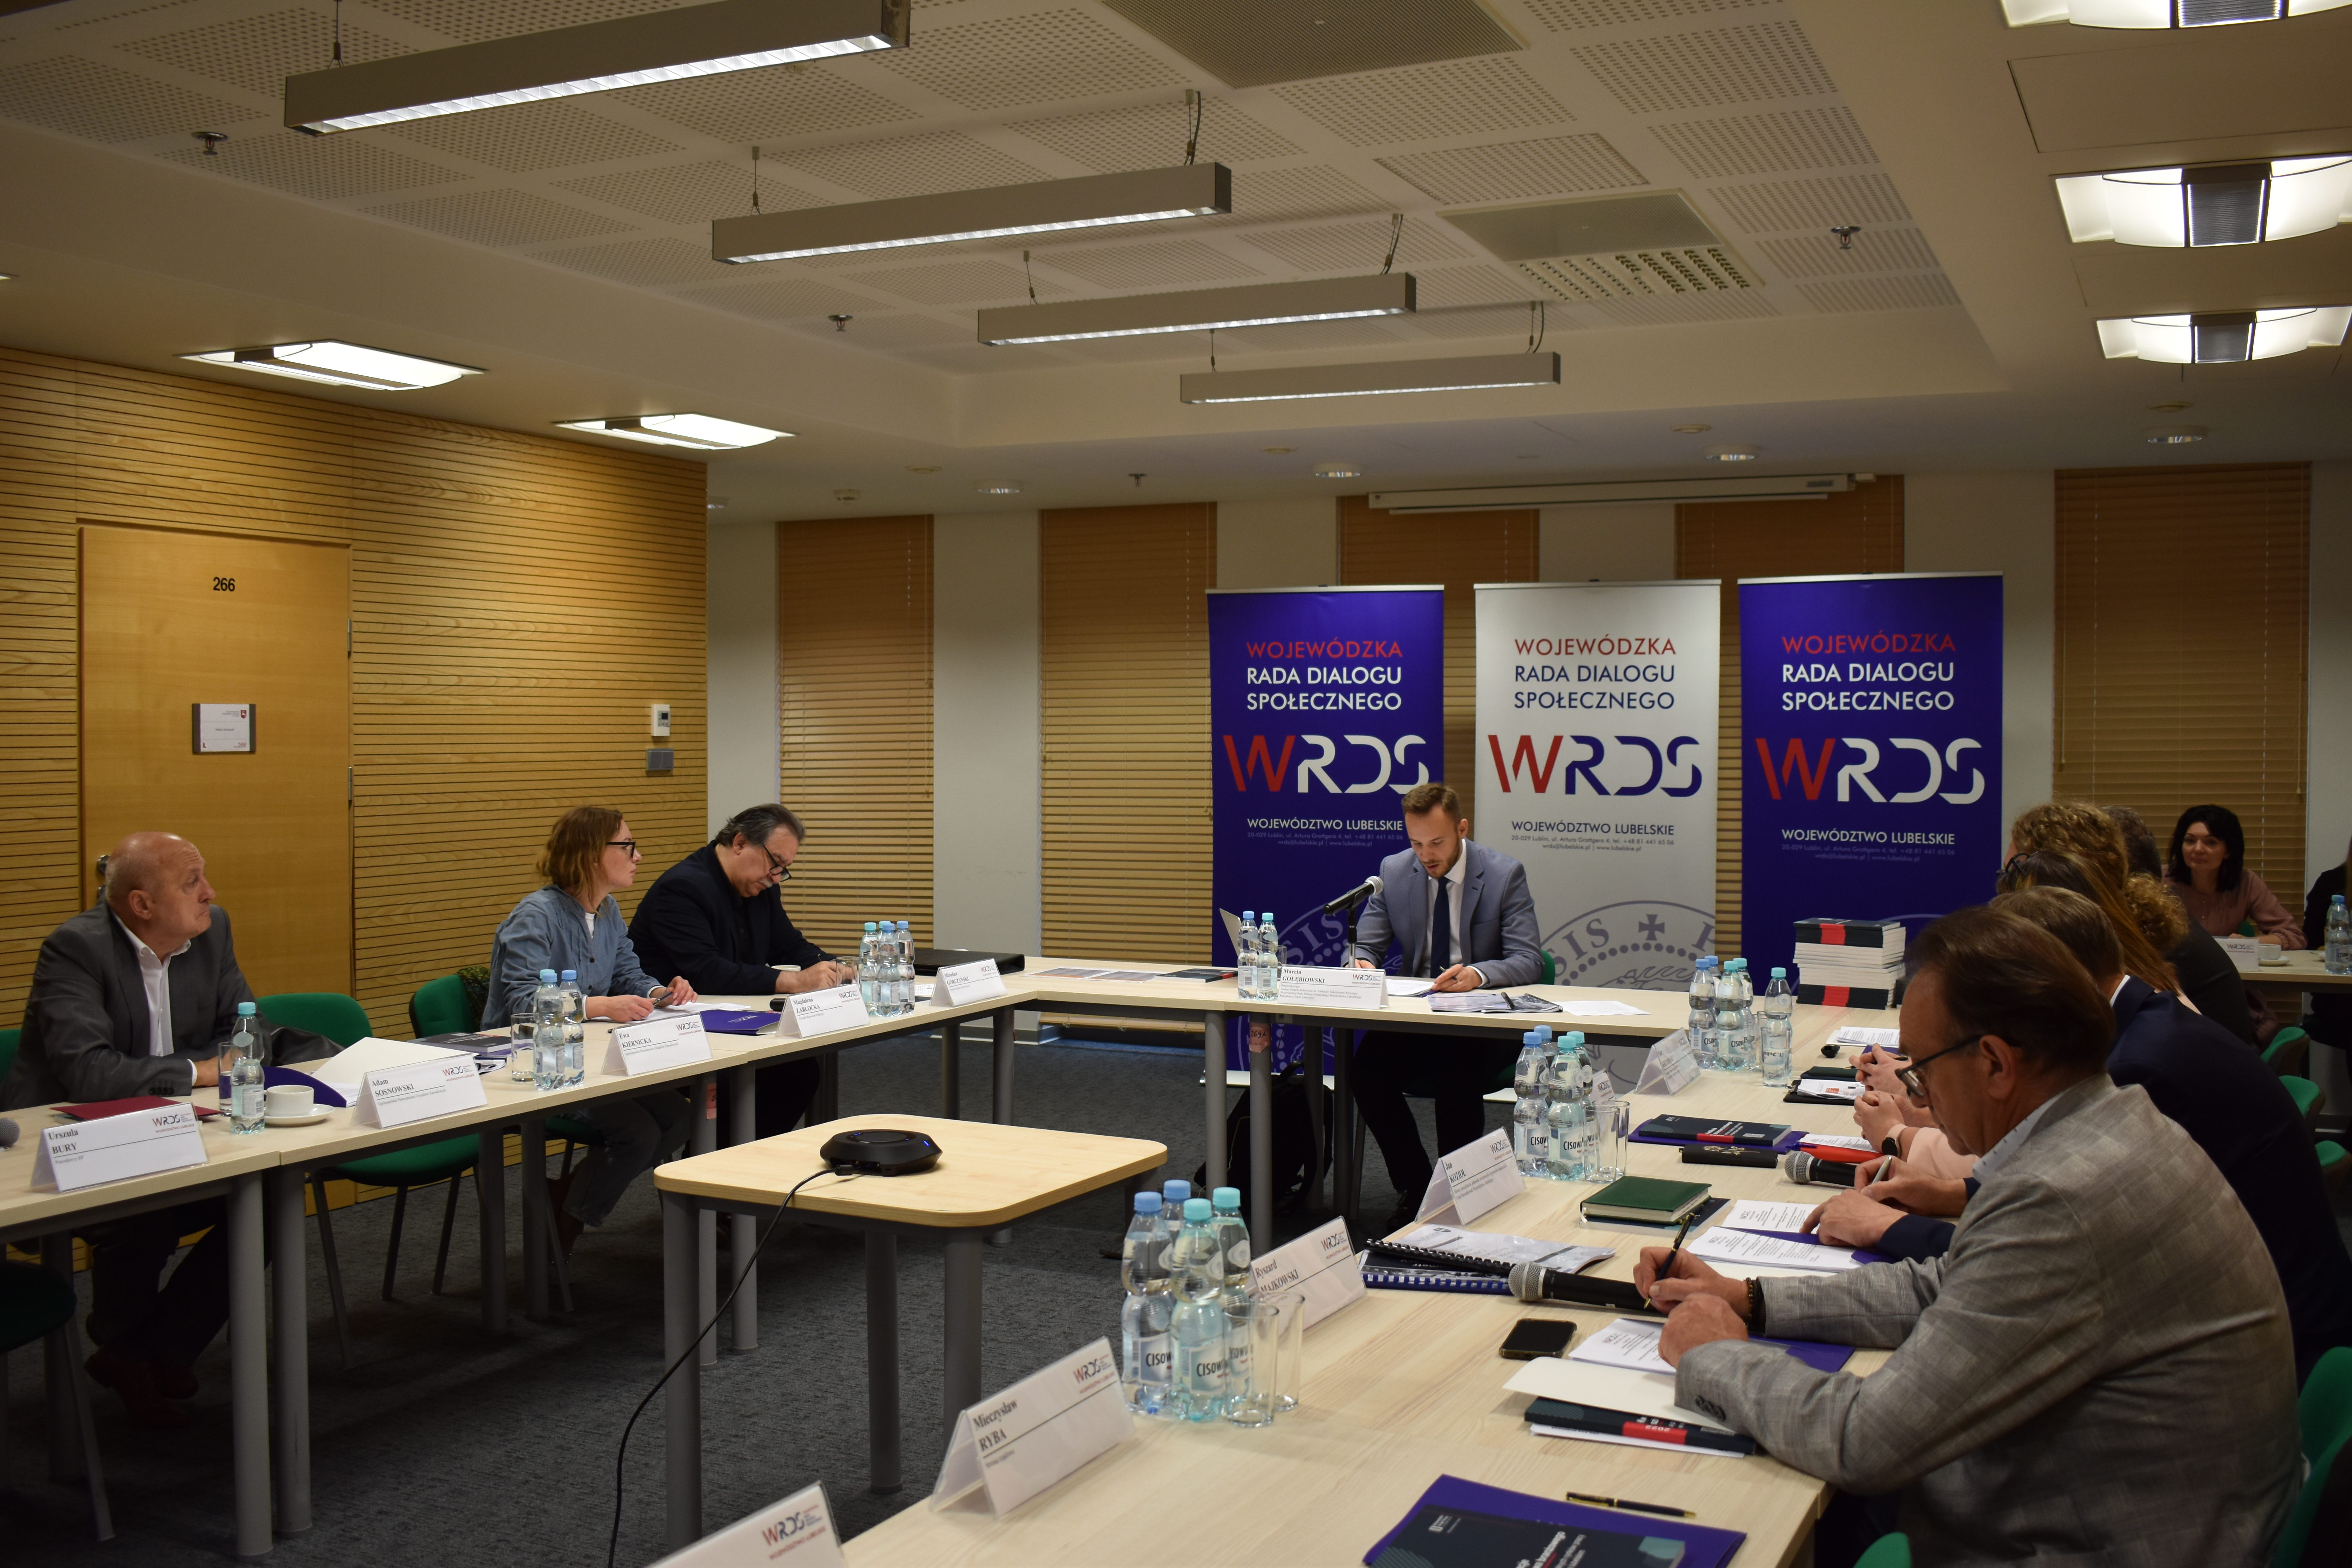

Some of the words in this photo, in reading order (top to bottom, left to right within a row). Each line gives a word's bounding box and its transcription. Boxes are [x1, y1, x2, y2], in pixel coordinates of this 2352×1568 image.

[213, 577, 235, 591] 266
[1246, 637, 1403, 659] WOJEWÓDZKA
[1514, 633, 1676, 656] WOJEWÓDZKA
[1782, 630, 1956, 655] WOJEWÓDZKA
[1247, 667, 1300, 685] RADA
[1307, 666, 1402, 685] DIALOGU
[1515, 665, 1570, 682] RADA
[1577, 665, 1675, 683] DIALOGU
[1782, 663, 1842, 682] RADA
[1849, 662, 1955, 682] DIALOGU
[1247, 692, 1402, 711] SPOŁECZNEGO
[1514, 691, 1675, 709] SPOŁECZNEGO
[1782, 691, 1955, 711] SPOŁECZNEGO
[1223, 734, 1430, 794] WRDS
[1488, 734, 1702, 797] WRDS
[1755, 738, 1985, 804] WRDS
[1247, 817, 1343, 829] WOJEWÓDZTWO
[1347, 820, 1403, 831] LUBELSKIE
[1512, 820, 1611, 833] WOJEWÓDZTWO
[1615, 824, 1674, 835] LUBELSKIE
[1782, 828, 1887, 842] WOJEWÓDZTWO
[1892, 832, 1955, 844] LUBELSKIE
[676, 1022, 693, 1031] WRDS
[622, 1038, 652, 1048] KIERNICKA
[443, 1066, 464, 1076] WRDS
[375, 1083, 415, 1097] SOSNOWSKI
[152, 1114, 181, 1126] WRDS
[49, 1129, 78, 1140] Urszula
[52, 1142, 77, 1154] BURY
[1490, 1140, 1504, 1154] WRDS
[1321, 1233, 1340, 1251] WRDS
[1255, 1259, 1278, 1279] Ryszard
[1260, 1269, 1299, 1291] MAJKOWSKI
[1146, 1351, 1171, 1367] CISOW
[1074, 1359, 1101, 1383] WRDS
[973, 1399, 1018, 1430] Mieczysław
[979, 1428, 1007, 1451] RYBA
[762, 1512, 805, 1546] WRDS
